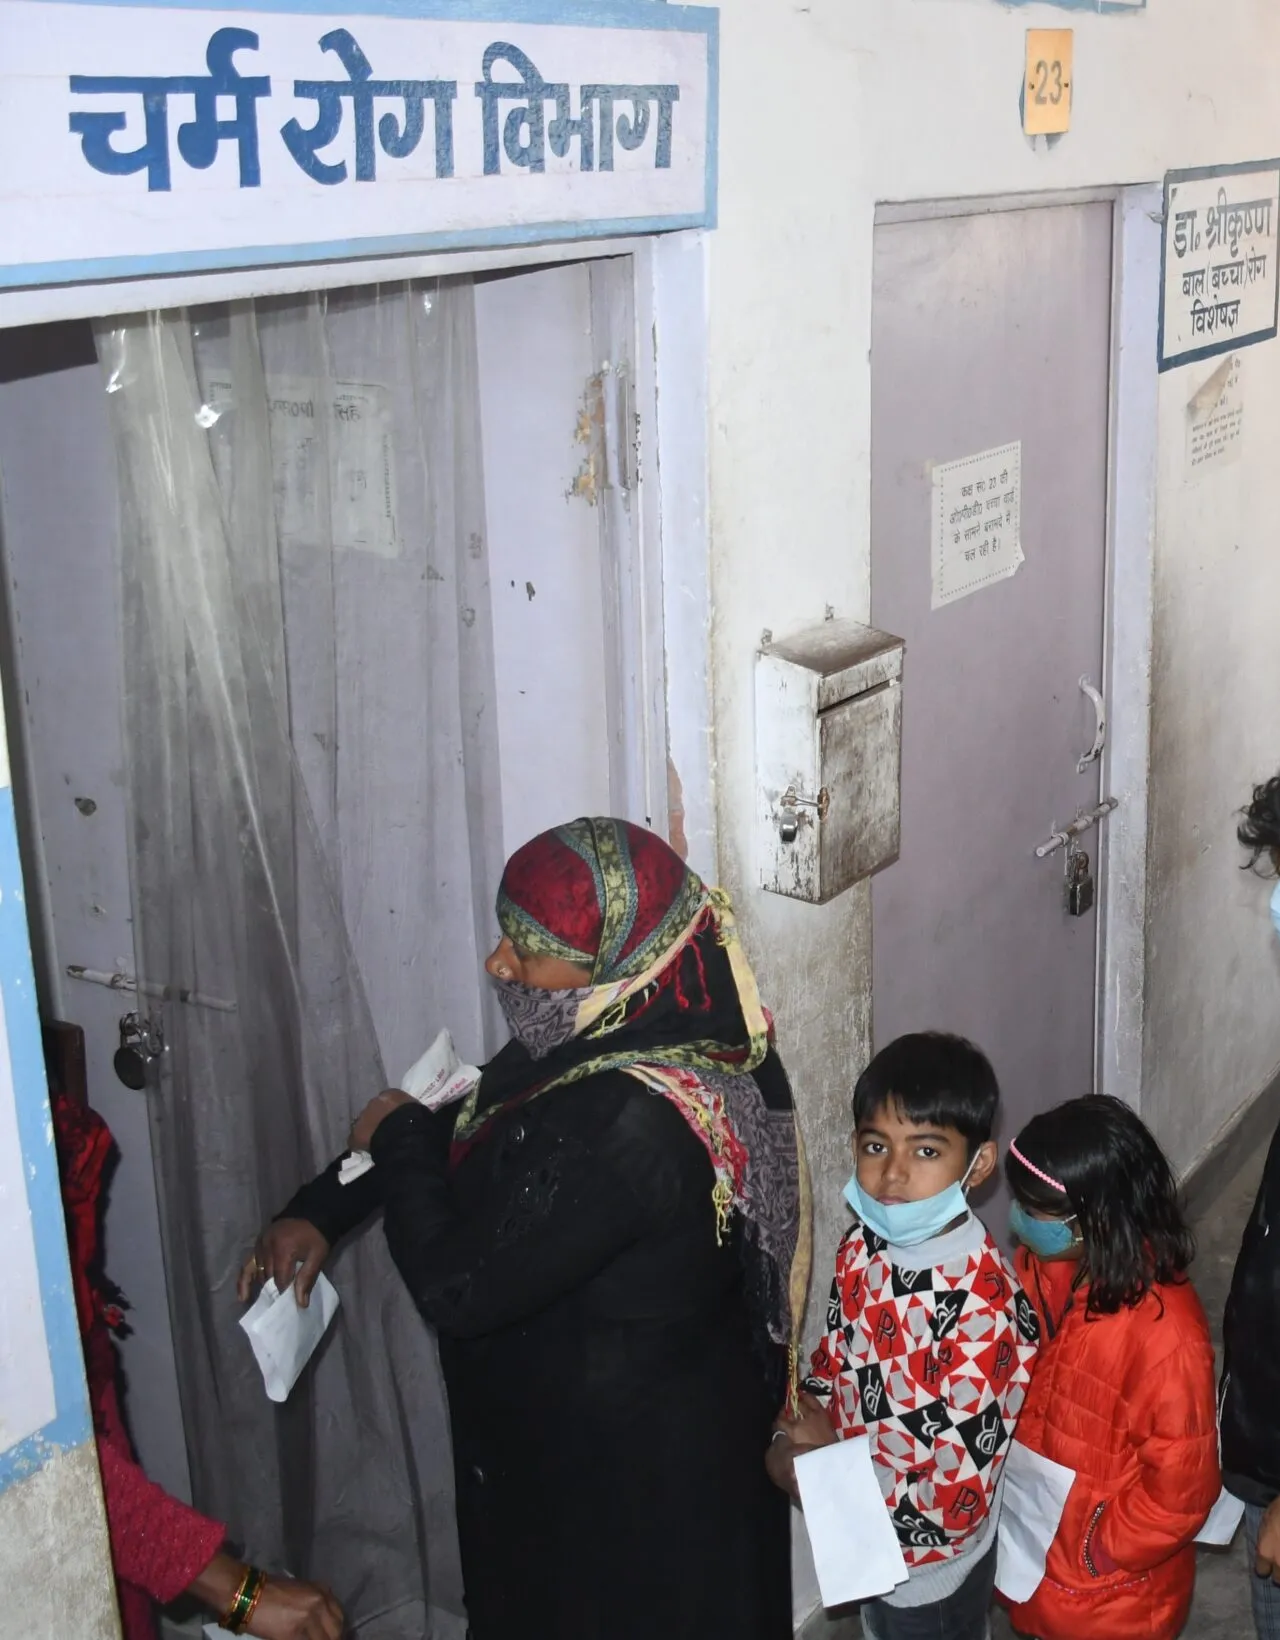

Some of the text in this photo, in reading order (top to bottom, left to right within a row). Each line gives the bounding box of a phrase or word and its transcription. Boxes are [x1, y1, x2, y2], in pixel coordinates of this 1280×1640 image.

[1034, 60, 1063, 105] 23
[69, 27, 680, 192] चर्म रोग विभाग
[1205, 186, 1273, 258] श्रीकृष्ण
[1182, 268, 1205, 297] बाल
[1249, 246, 1267, 288] रोग
[1190, 294, 1241, 337] विशेषज्ञ
[988, 476, 997, 490] 23
[999, 468, 1009, 485] की
[953, 526, 961, 545] के
[963, 521, 981, 543] सामने
[964, 548, 976, 563] चल
[979, 539, 989, 557] रही
